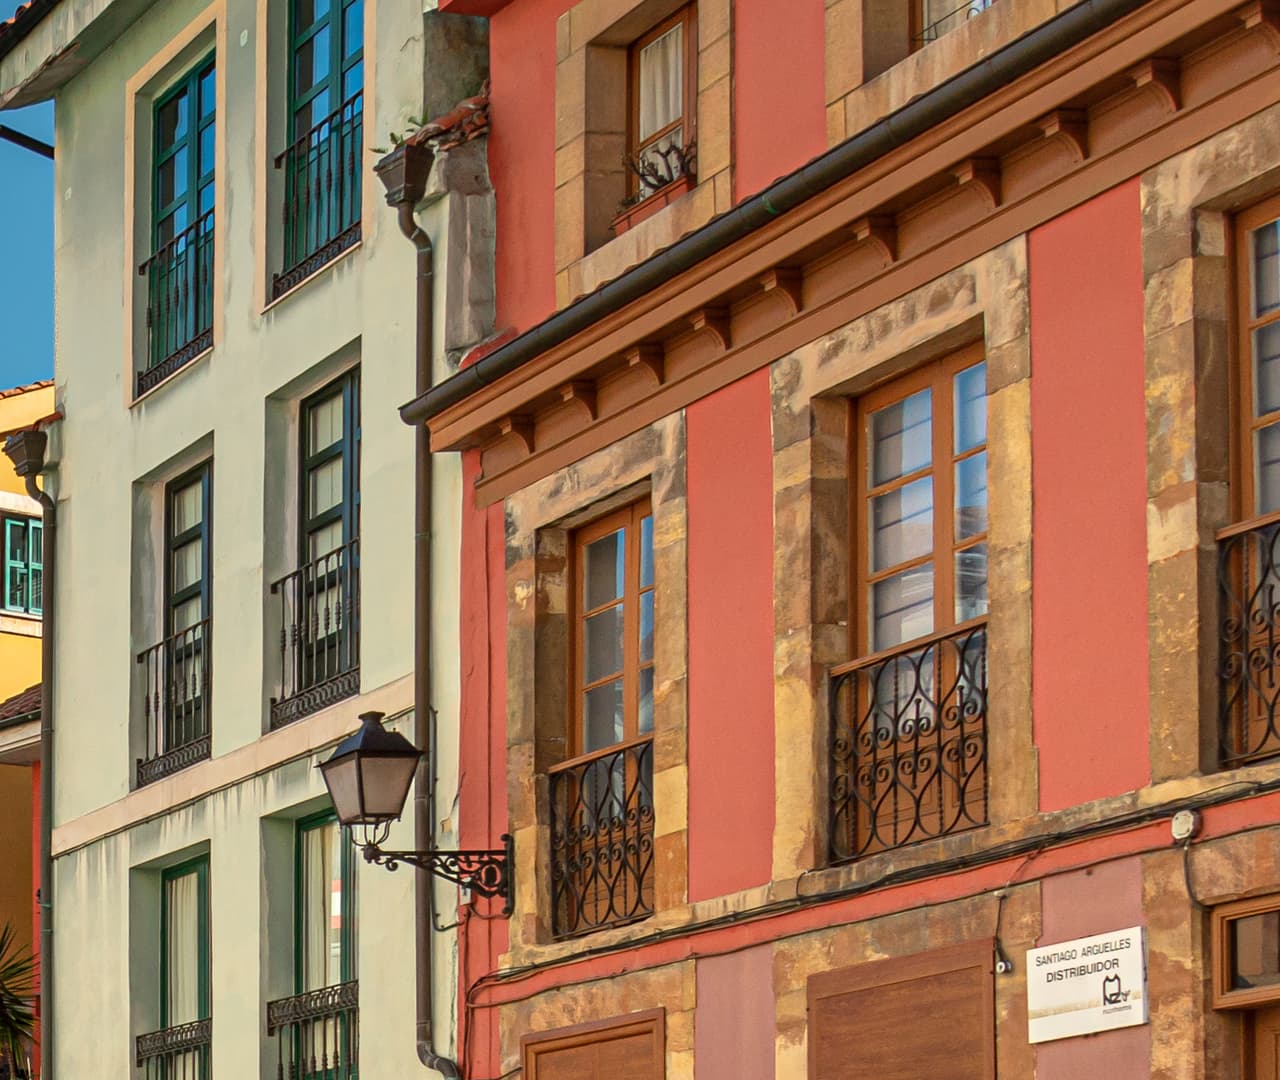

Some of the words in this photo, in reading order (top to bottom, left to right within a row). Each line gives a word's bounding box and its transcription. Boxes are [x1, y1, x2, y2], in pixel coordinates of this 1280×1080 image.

[1036, 949, 1077, 967] SANTIAGO
[1081, 938, 1131, 957] ARGUELLES
[1046, 958, 1120, 983] DISTRIBUIDOR
